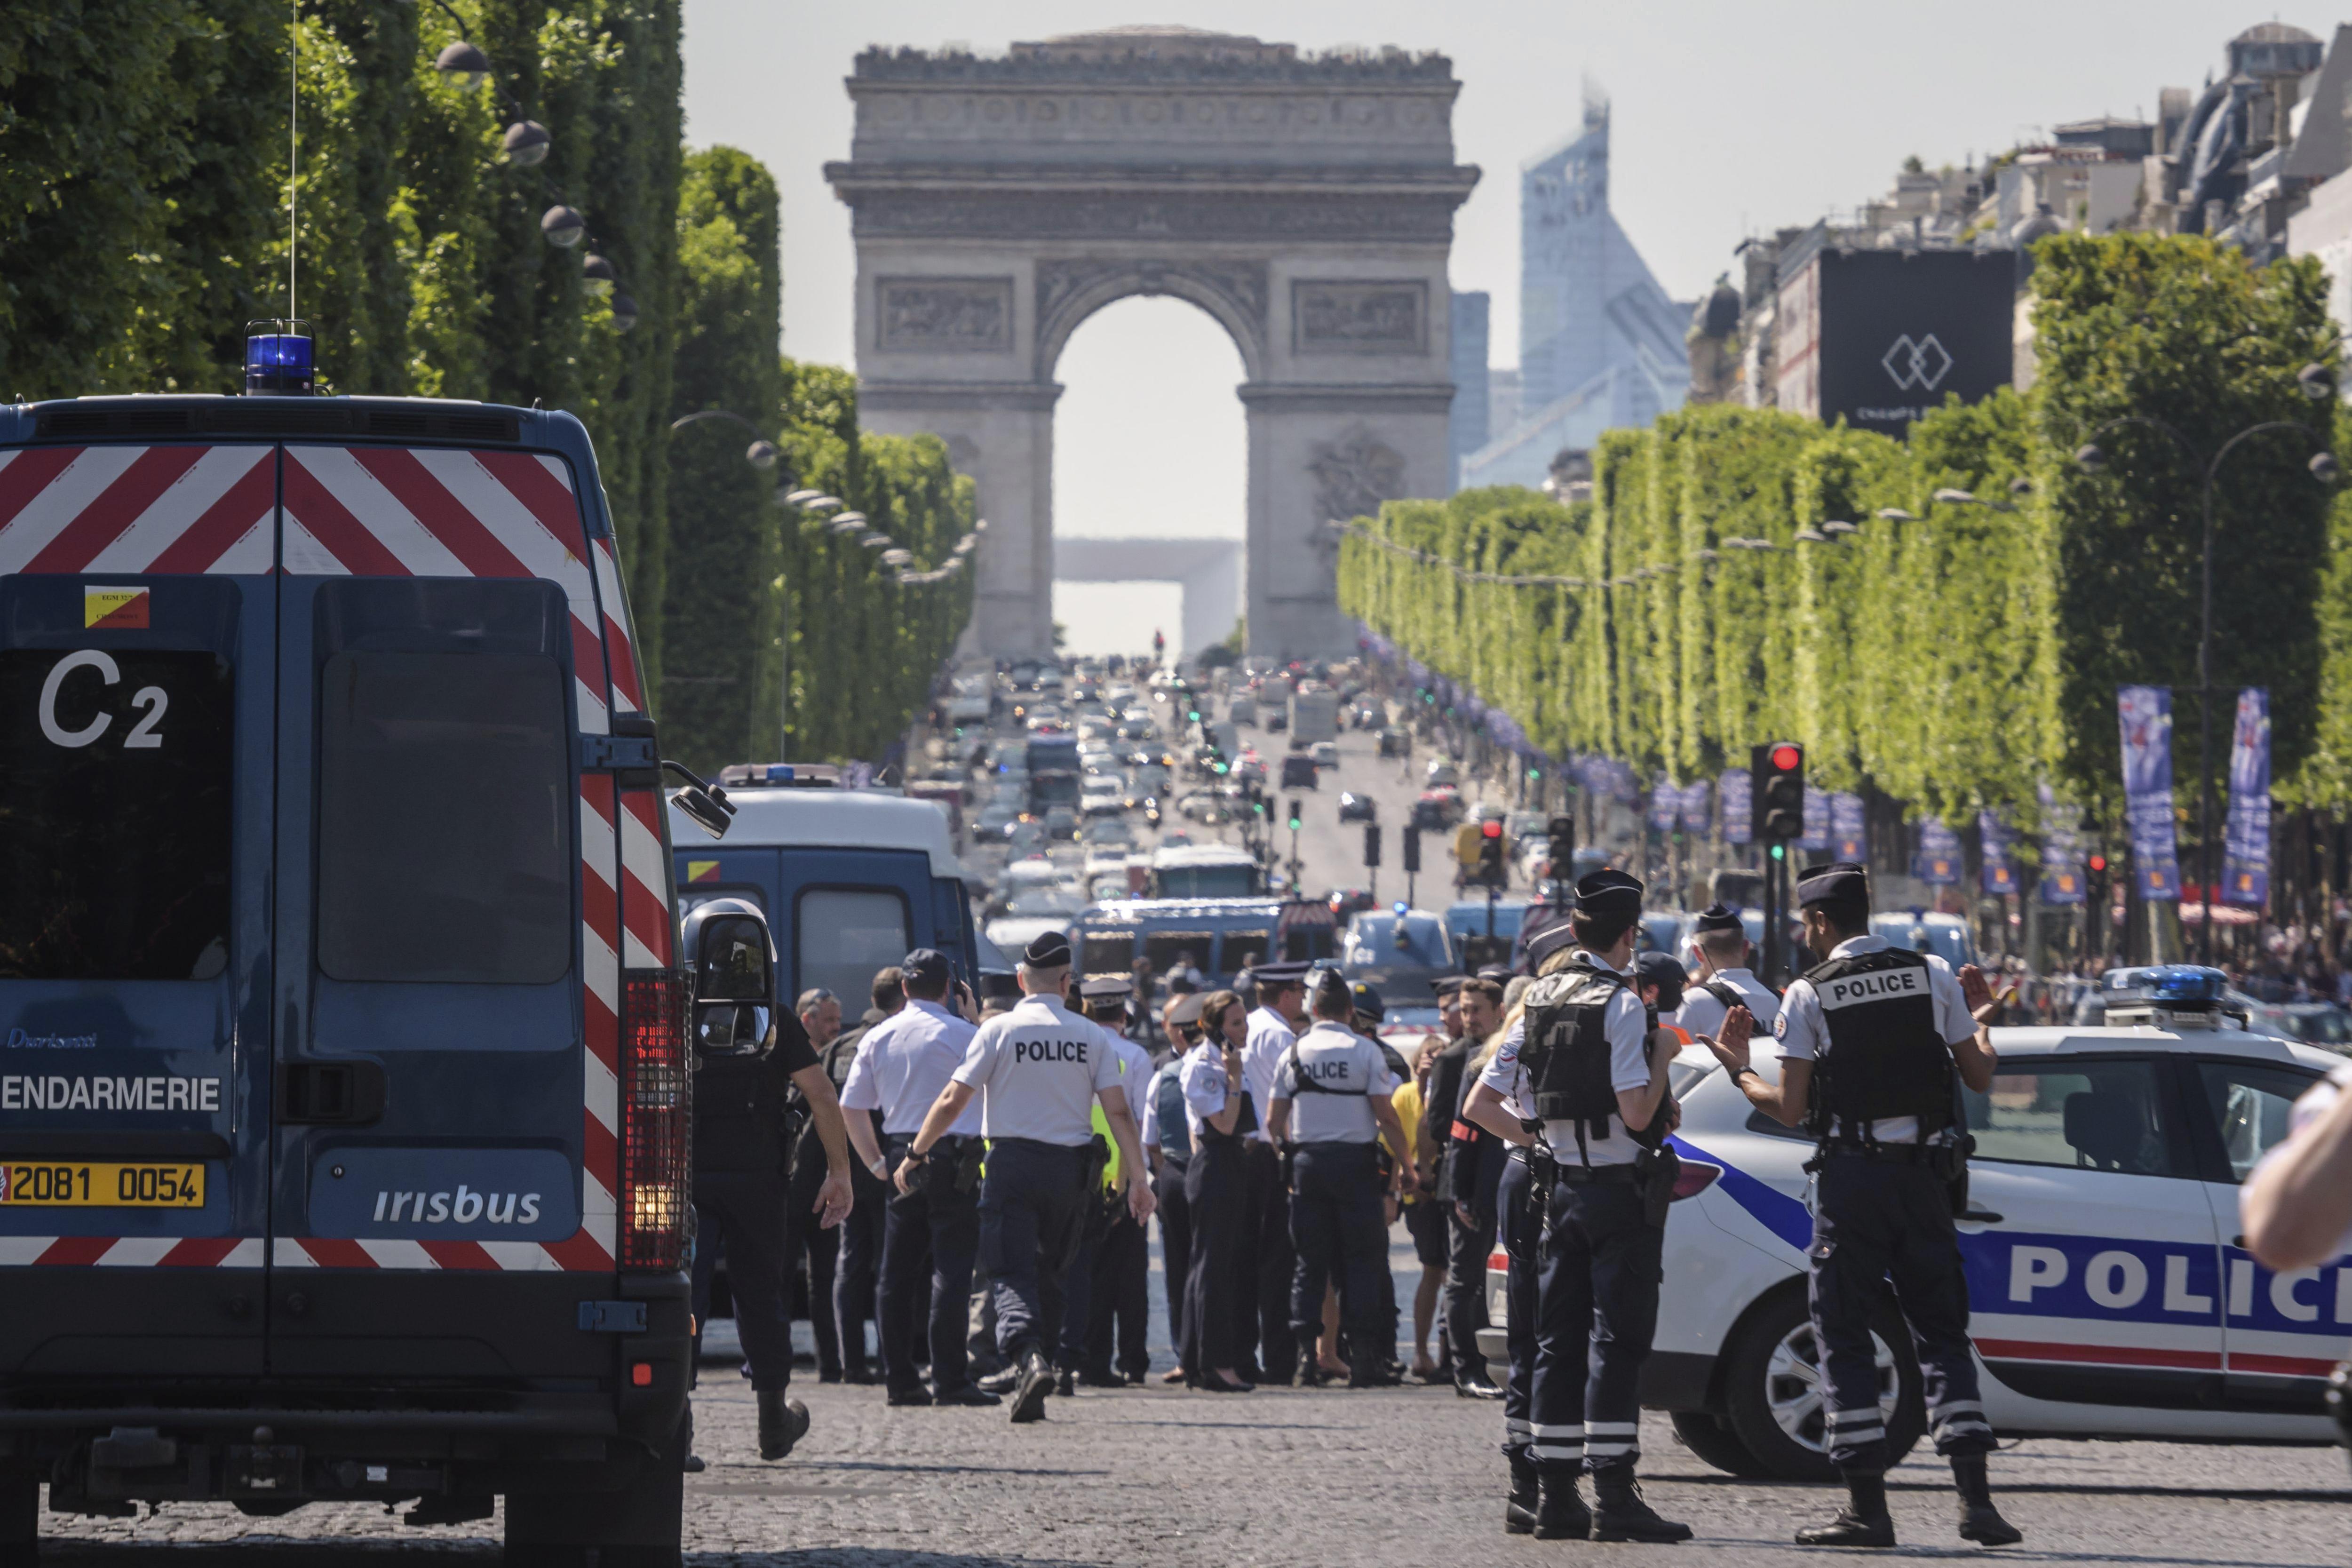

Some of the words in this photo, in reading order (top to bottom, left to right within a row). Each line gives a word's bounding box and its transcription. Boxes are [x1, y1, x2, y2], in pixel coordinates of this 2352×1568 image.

[1834, 972, 1916, 1001] POLICE
[1015, 1041, 1088, 1063] POLICE
[1302, 1061, 1348, 1079] OLICE
[13, 1167, 90, 1201] 2081
[119, 1168, 197, 1202] 0054
